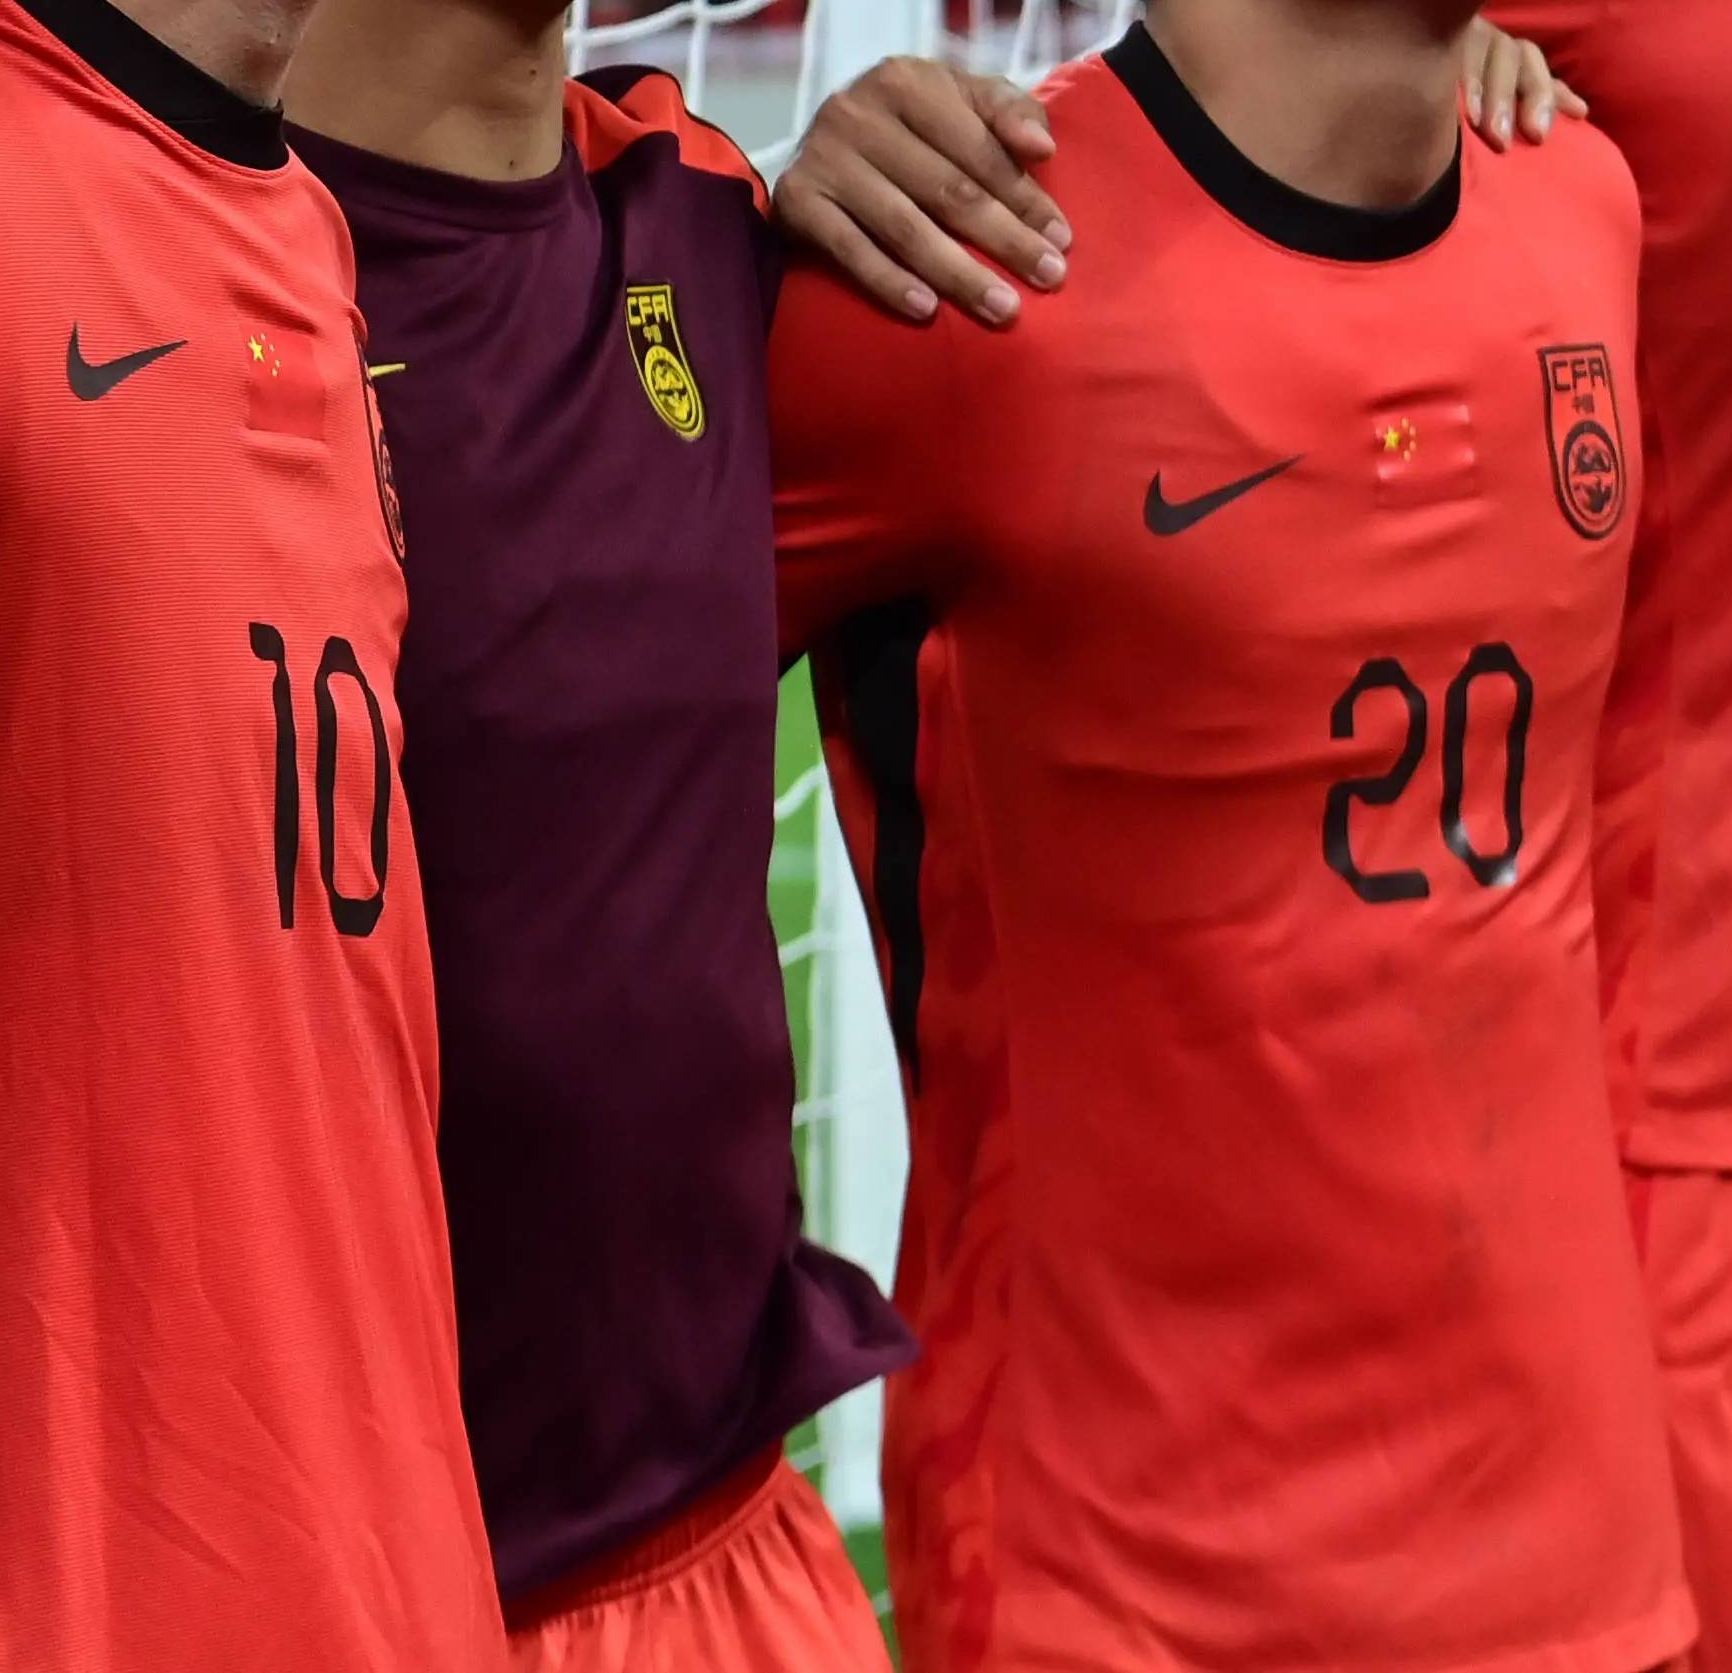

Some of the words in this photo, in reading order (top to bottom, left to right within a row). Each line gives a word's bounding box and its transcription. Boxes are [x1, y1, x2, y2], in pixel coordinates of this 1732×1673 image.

[627, 294, 669, 326] CFA
[1551, 357, 1607, 392] CFA
[249, 622, 390, 937] 10
[1323, 642, 1533, 903] 20
